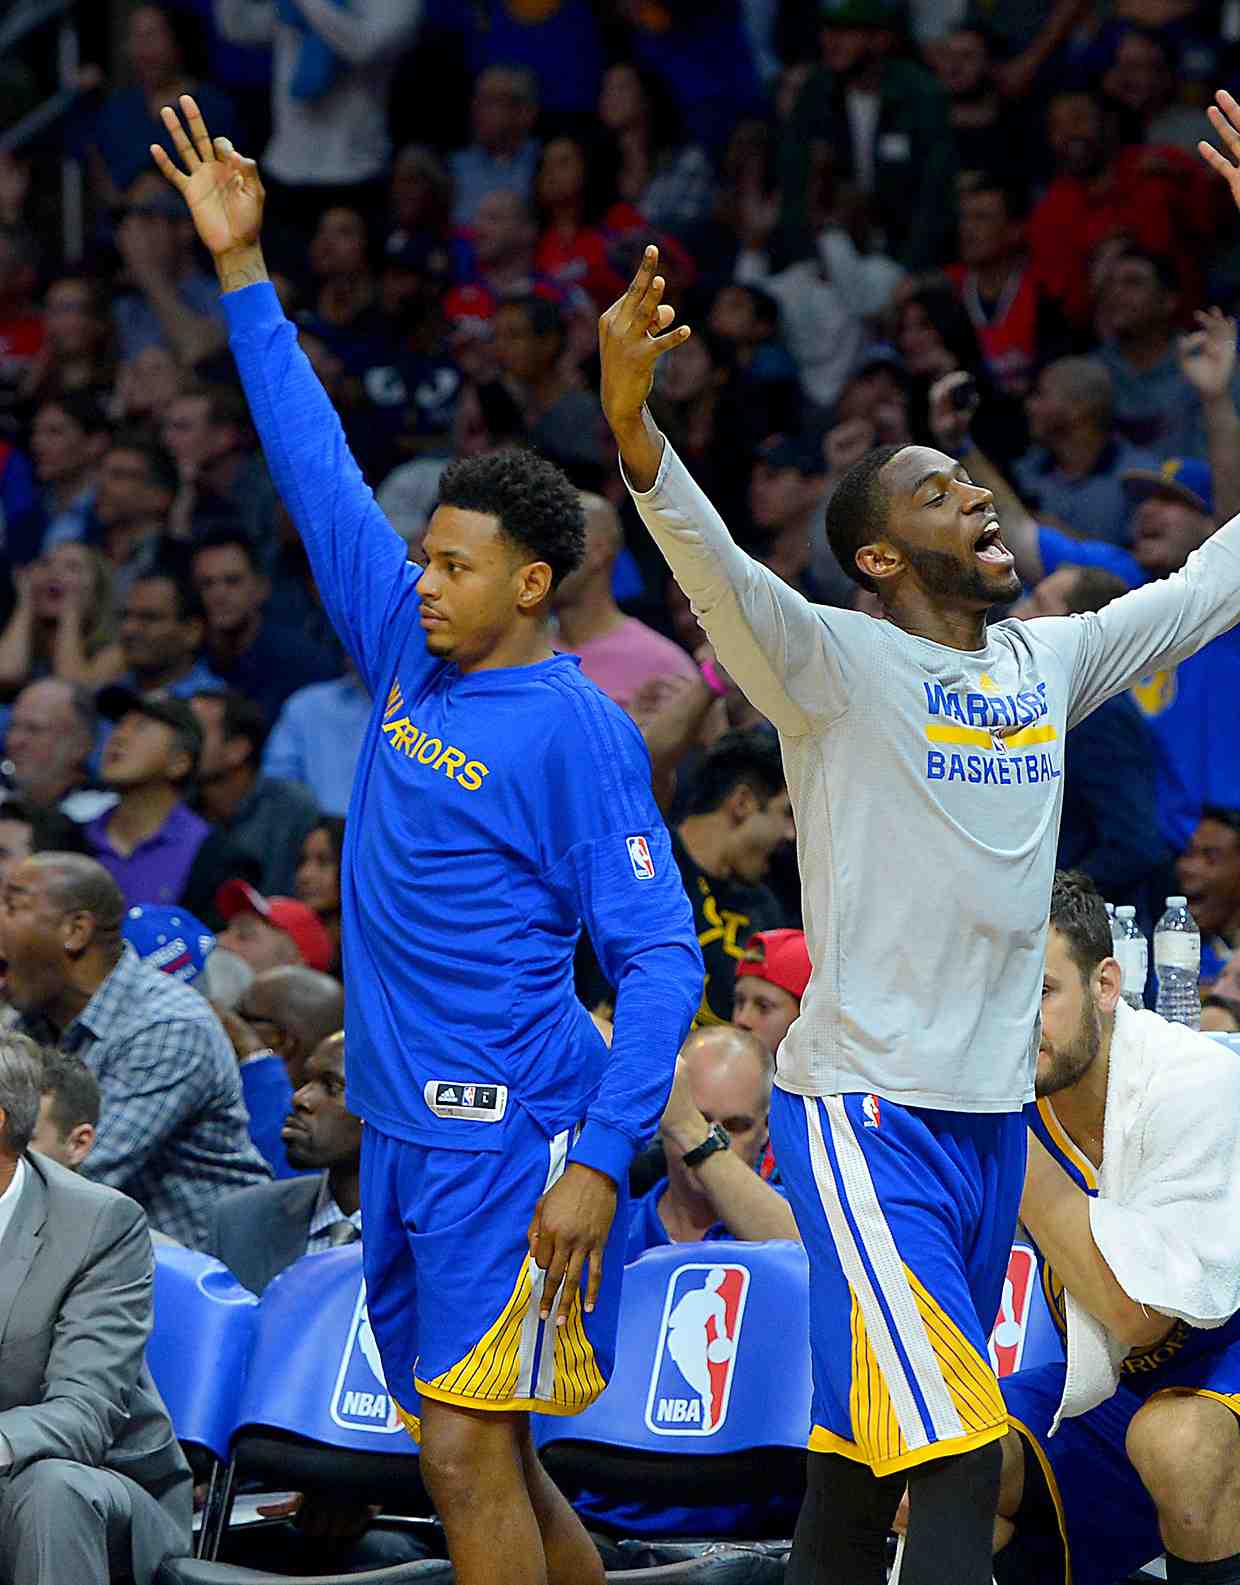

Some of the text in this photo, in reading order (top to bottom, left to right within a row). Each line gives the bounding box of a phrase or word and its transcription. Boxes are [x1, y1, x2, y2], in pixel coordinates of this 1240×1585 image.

[927, 751, 1061, 785] BASKETBAL
[342, 1391, 387, 1418] NBA
[656, 1398, 701, 1422] NBA
